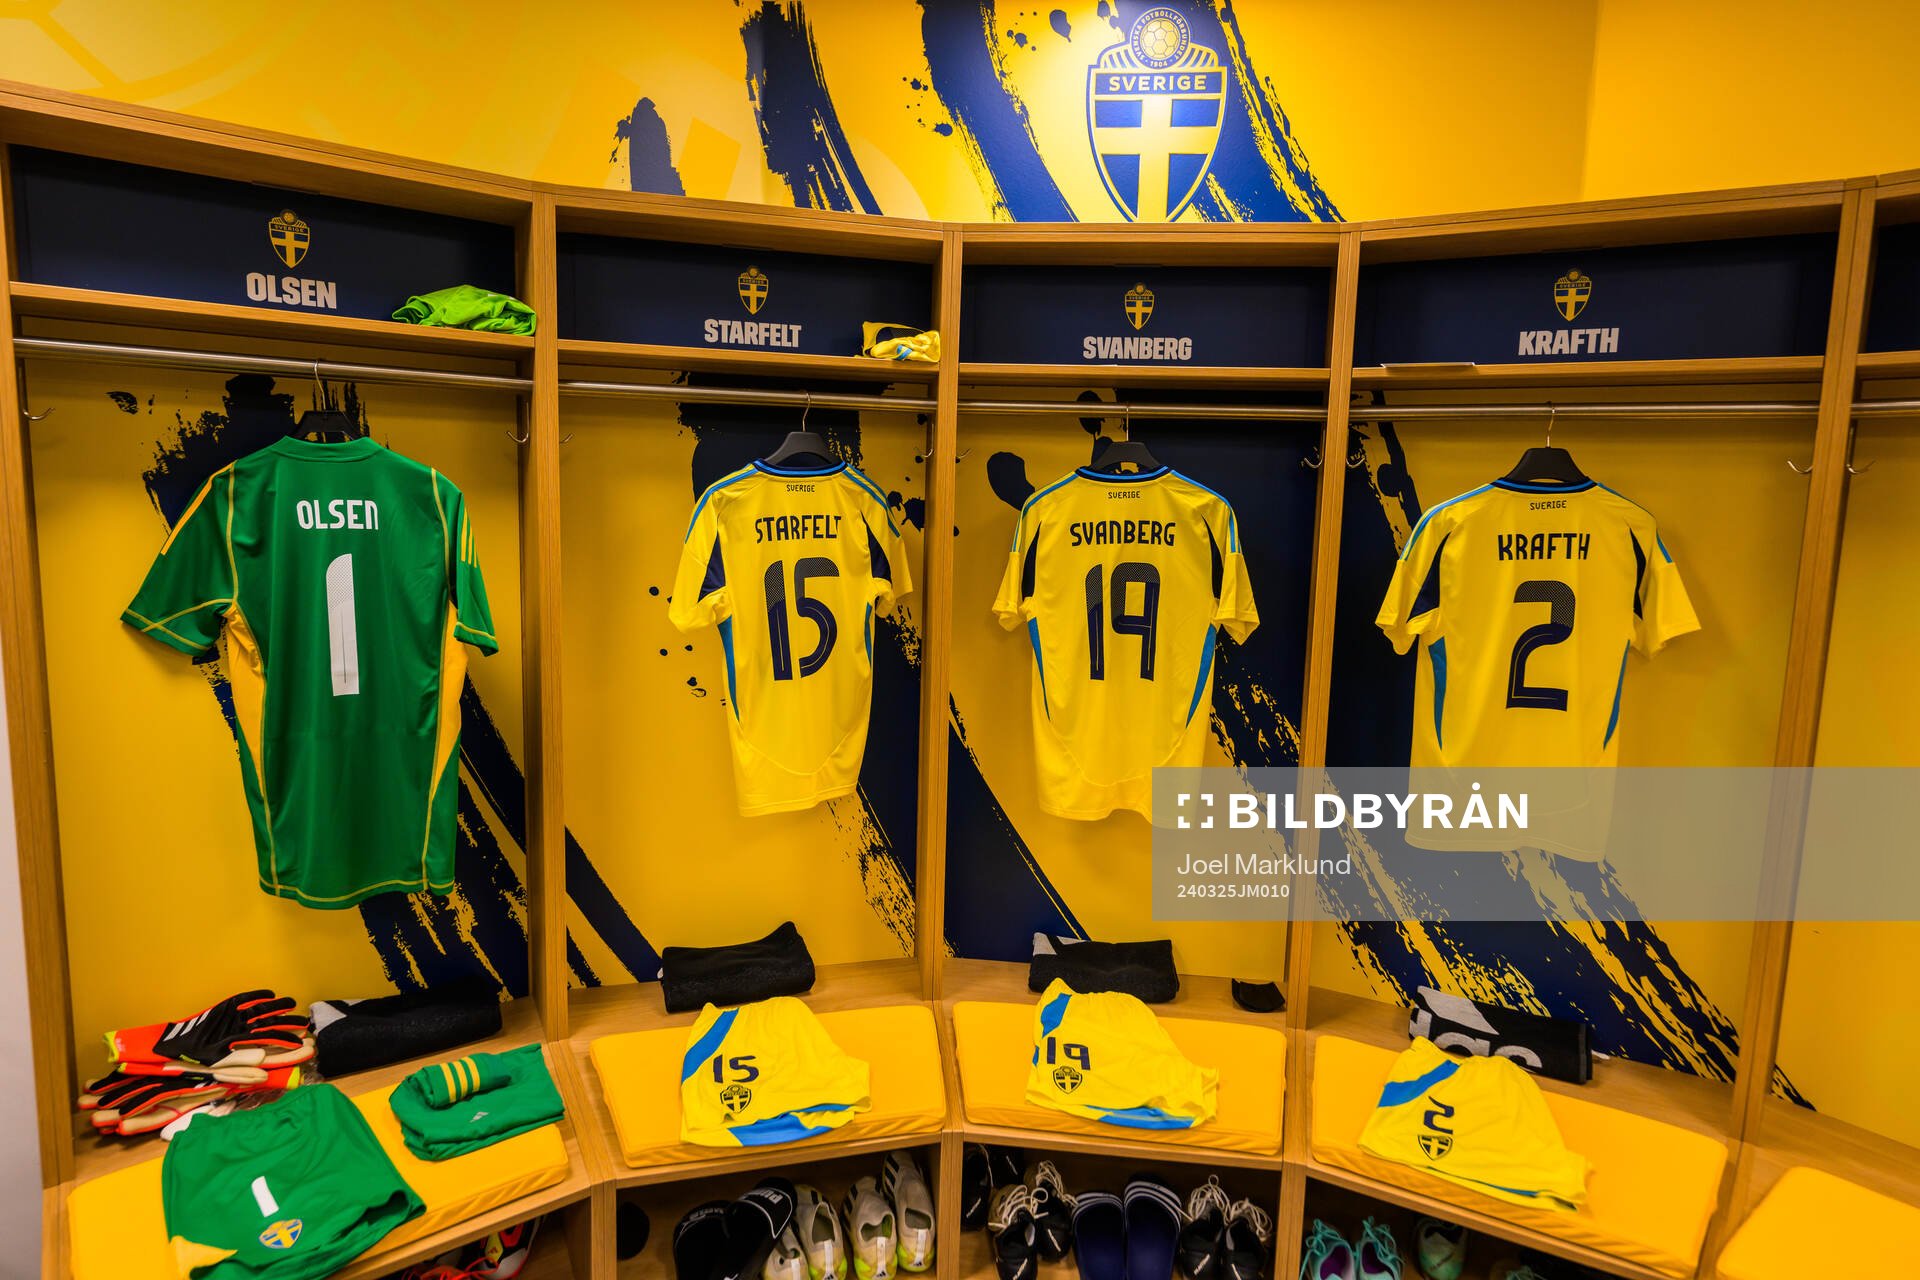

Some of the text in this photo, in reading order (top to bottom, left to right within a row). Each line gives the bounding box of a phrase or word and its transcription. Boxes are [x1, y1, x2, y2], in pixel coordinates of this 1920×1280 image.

[1109, 75, 1207, 91] SVERIGE
[246, 272, 337, 309] OLSEN
[704, 318, 801, 347] STARFELT
[1518, 327, 1619, 356] KRAFTH
[1083, 336, 1192, 360] SVANBERG
[786, 484, 815, 492] SVERIGE
[1108, 491, 1140, 499] SVERIGE
[296, 499, 378, 530] OLSEN
[1530, 500, 1567, 510] SVERIGE
[755, 514, 842, 543] STARFELT
[1070, 520, 1176, 546] SVANBERG
[1498, 533, 1591, 560] KRAFTH
[326, 553, 360, 696] 1
[764, 557, 840, 681] 15
[1085, 562, 1160, 682] 19
[1506, 580, 1576, 712] 2
[1047, 1037, 1090, 1070] 19
[713, 1054, 759, 1083] 15
[1424, 1096, 1454, 1134] 2
[251, 1176, 280, 1217] 1
